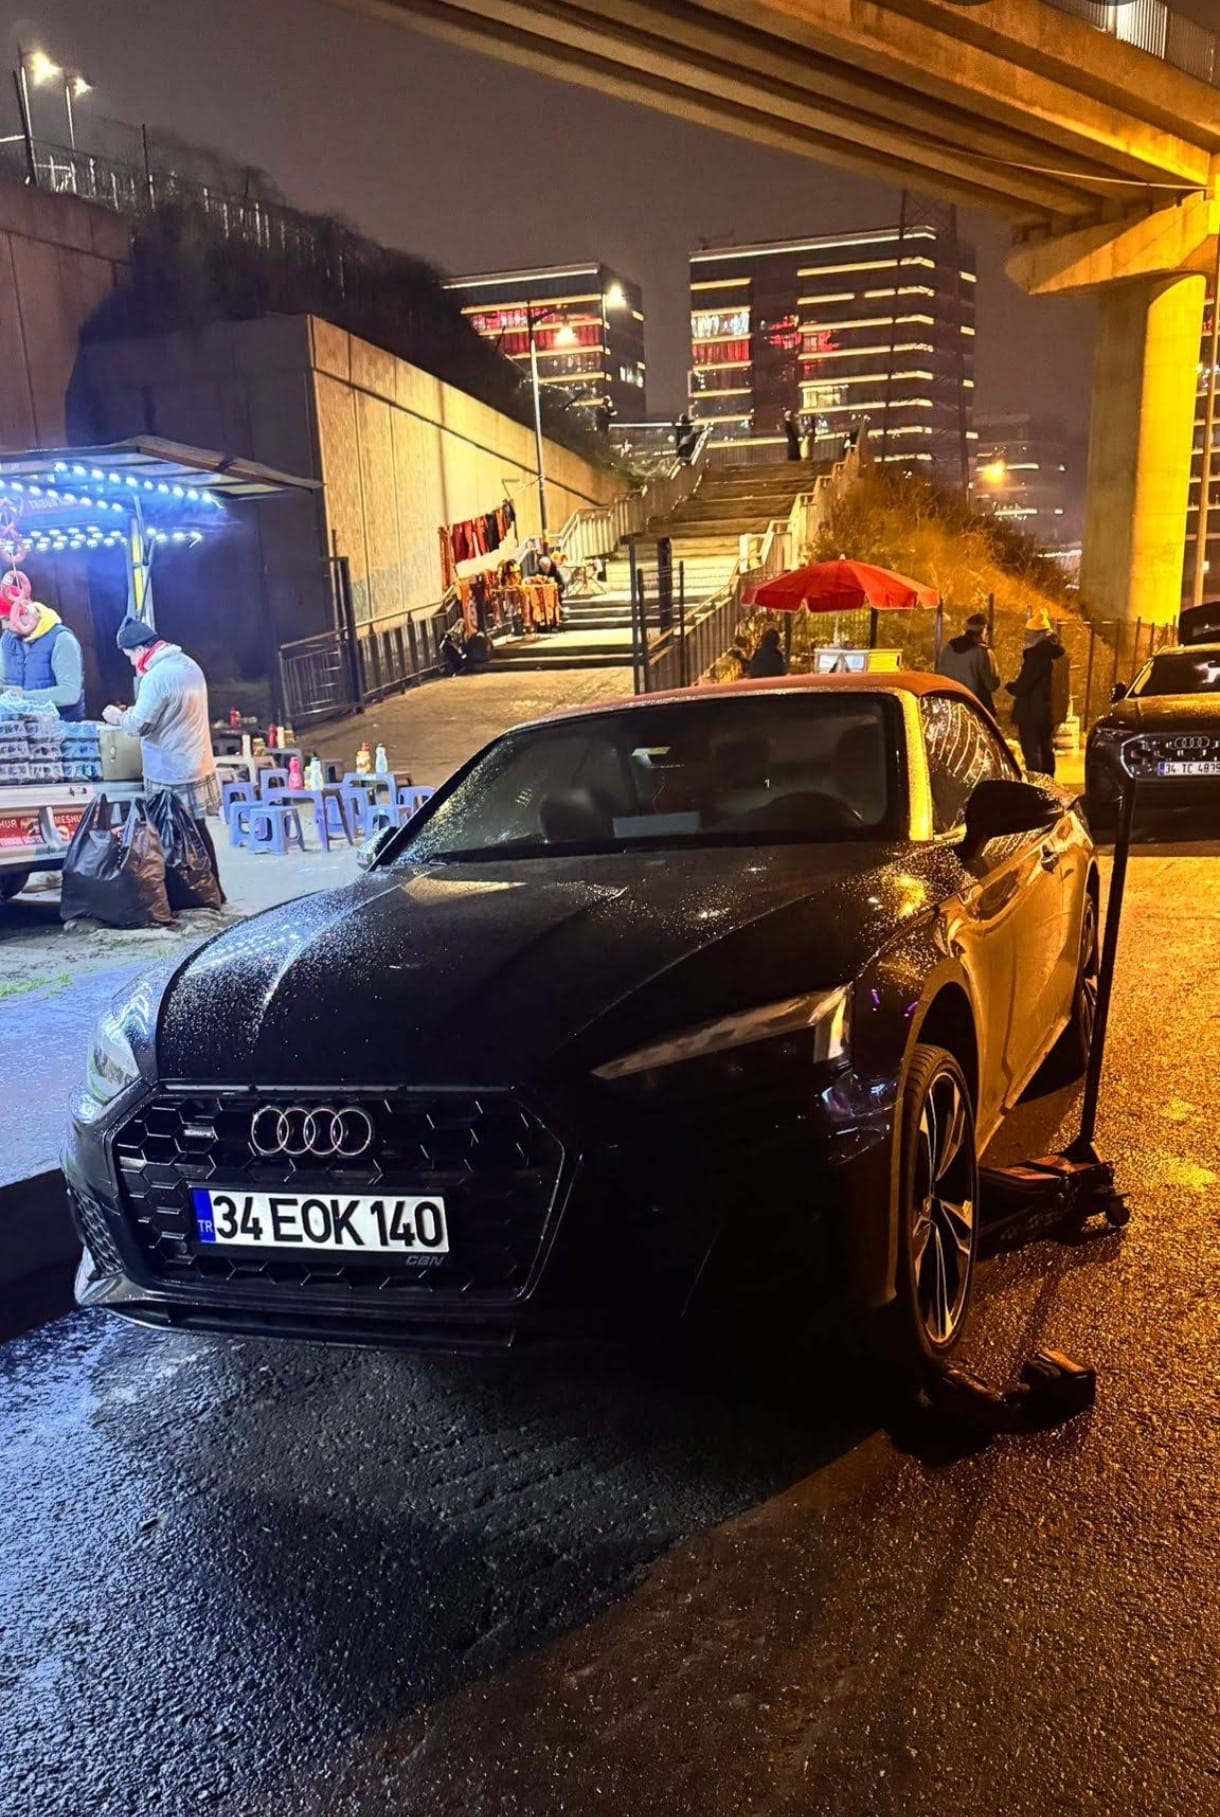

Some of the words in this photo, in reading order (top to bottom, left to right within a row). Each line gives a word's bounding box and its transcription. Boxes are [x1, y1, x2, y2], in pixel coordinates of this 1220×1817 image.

[1166, 763, 1176, 774] 34
[1182, 763, 1193, 774] TC
[197, 1219, 213, 1233] TR
[213, 1195, 263, 1240] 34
[268, 1197, 365, 1246] EOK
[370, 1199, 444, 1247] 140
